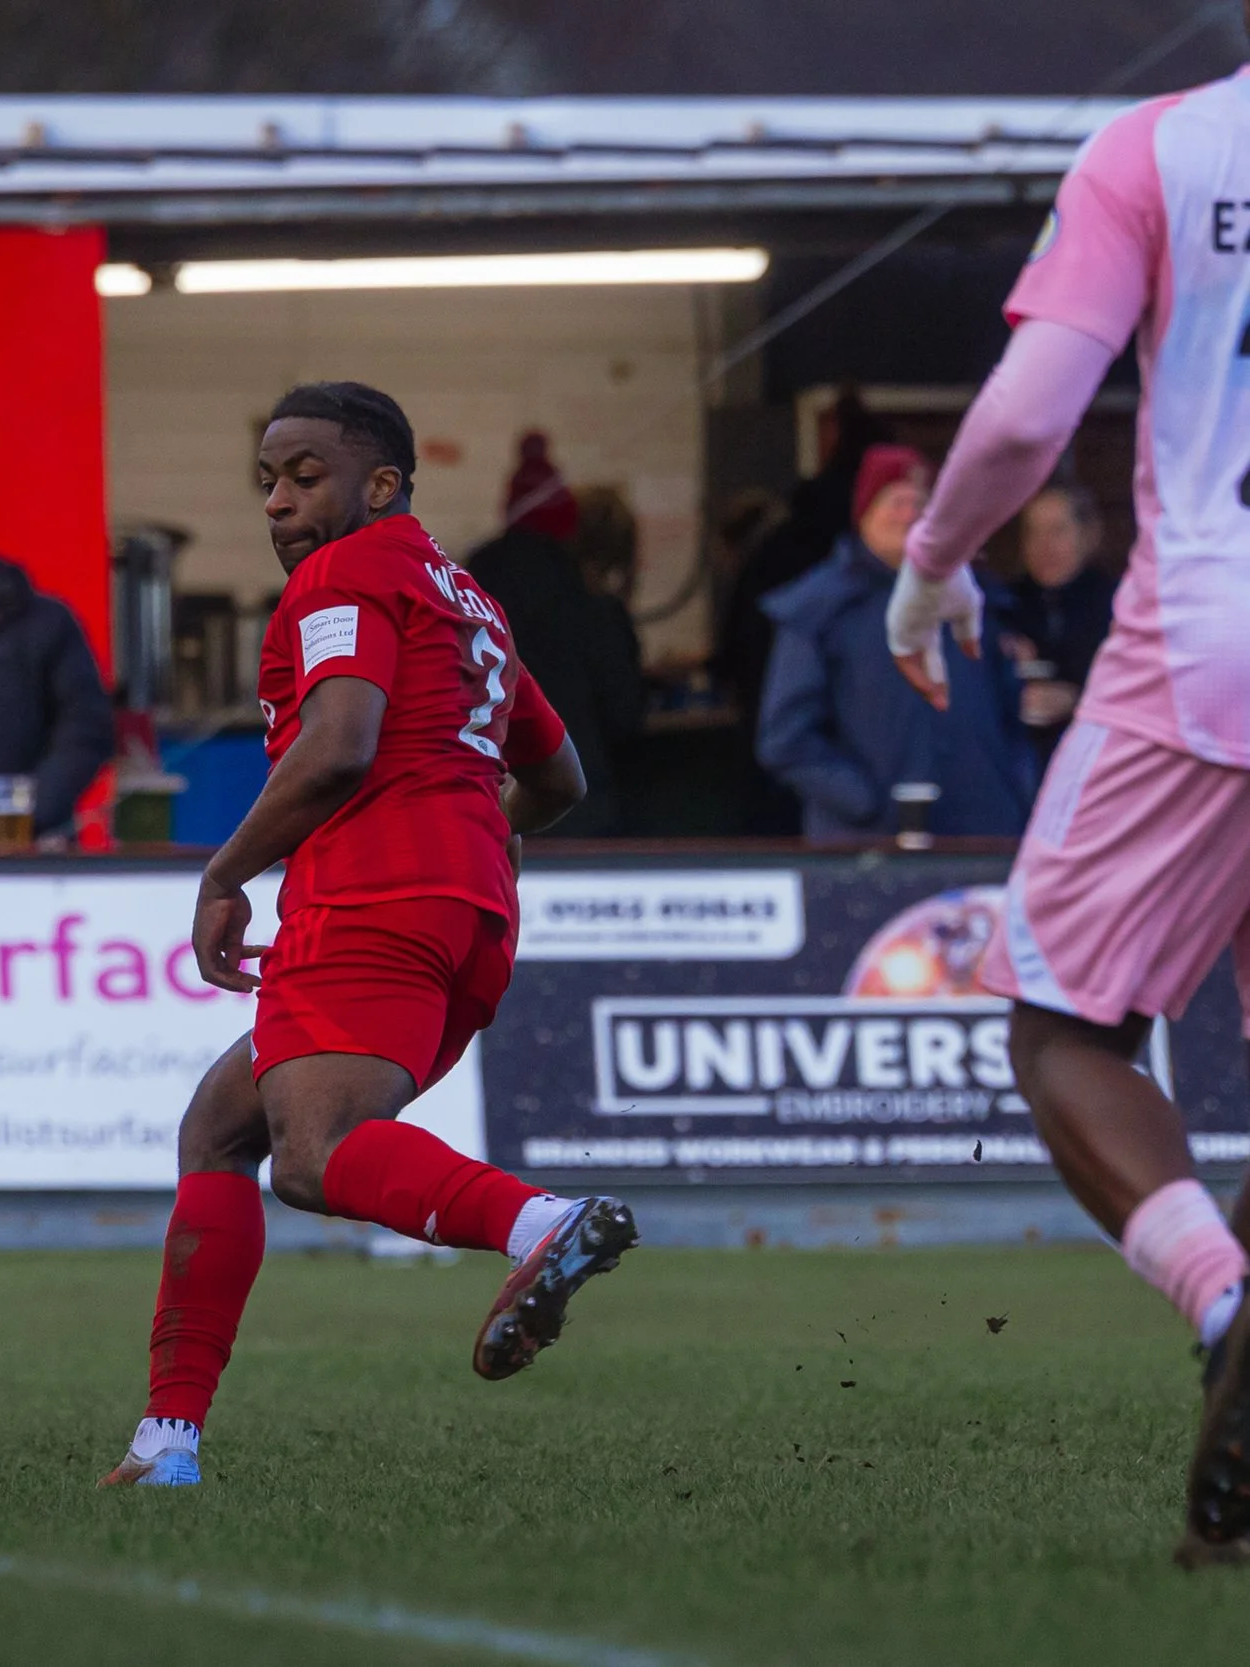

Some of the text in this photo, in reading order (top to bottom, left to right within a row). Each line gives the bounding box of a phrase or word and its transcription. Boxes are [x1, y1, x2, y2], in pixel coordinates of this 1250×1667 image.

[333, 616, 354, 624] Door
[339, 628, 354, 637] Ltd
[458, 626, 507, 759] 2
[612, 1017, 1017, 1092] UNIVERS
